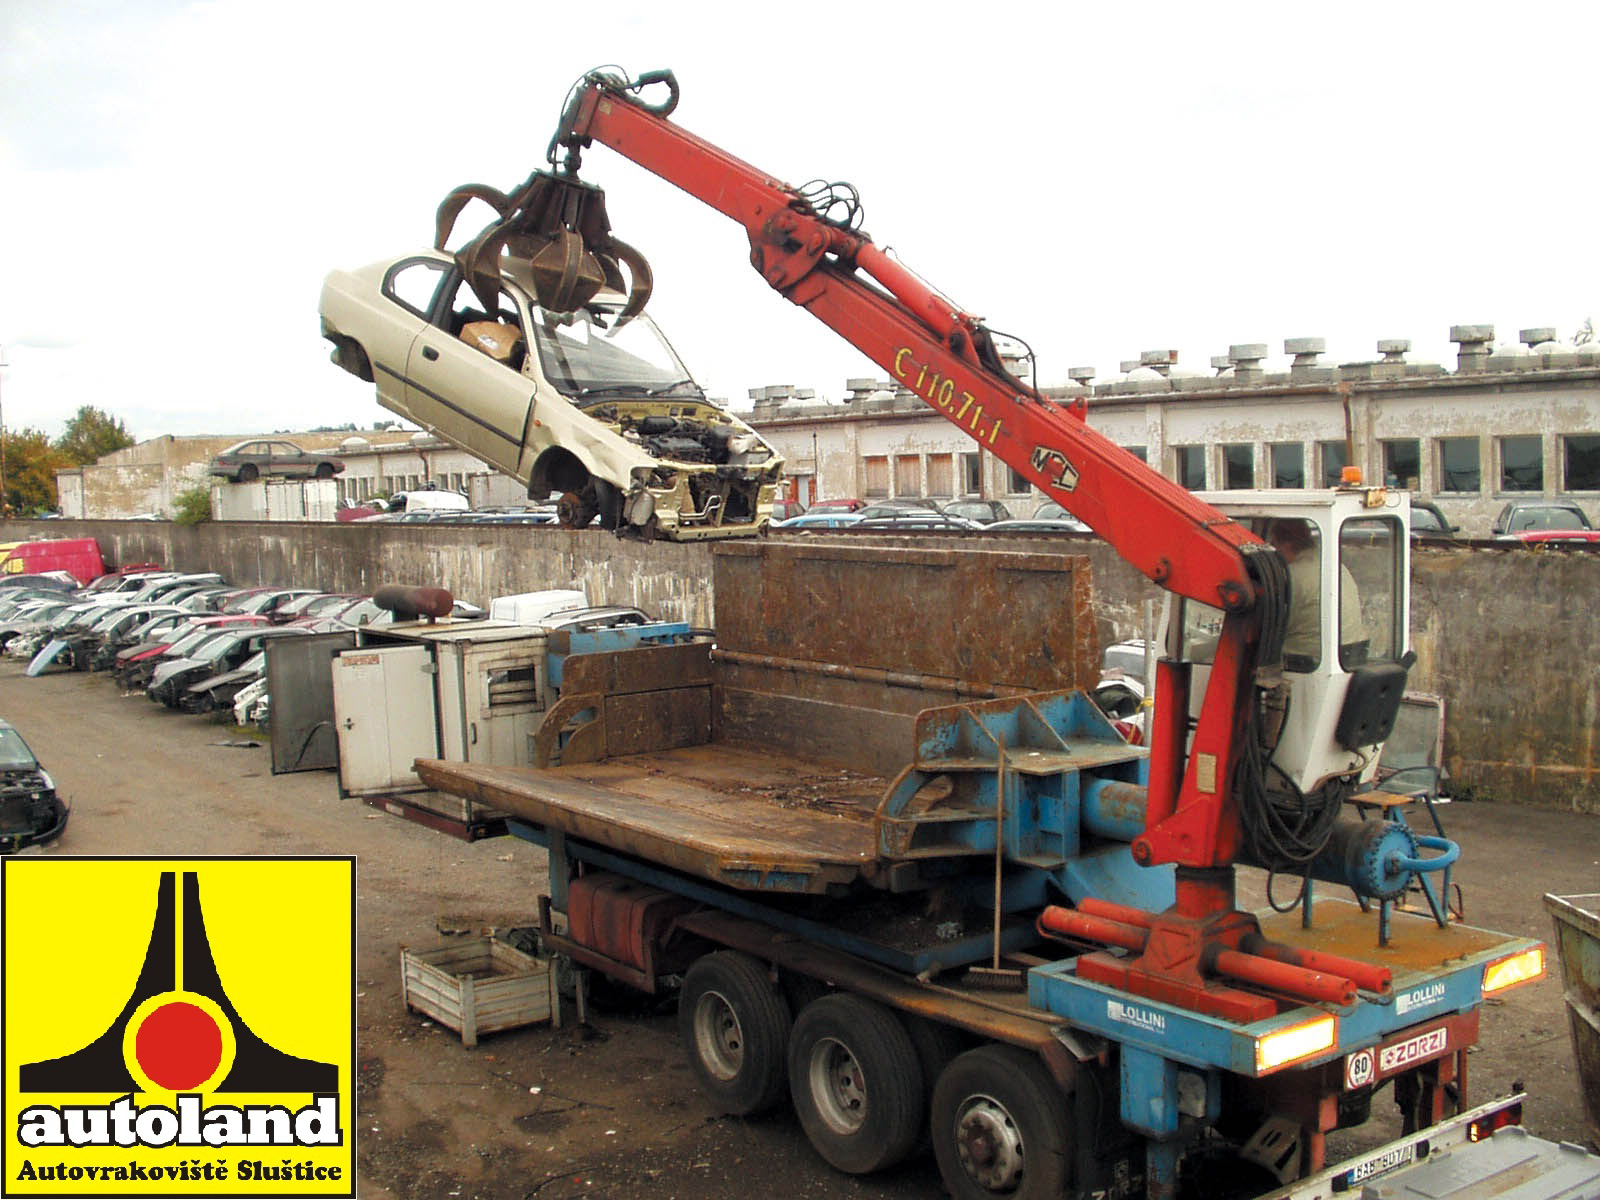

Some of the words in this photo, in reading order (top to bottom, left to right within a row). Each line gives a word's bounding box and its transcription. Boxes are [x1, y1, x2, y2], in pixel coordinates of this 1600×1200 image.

[895, 348, 912, 377] C
[916, 365, 1002, 444] 110.71.1
[1396, 1031, 1443, 1063] ZORZI
[1354, 1056, 1368, 1075] 80
